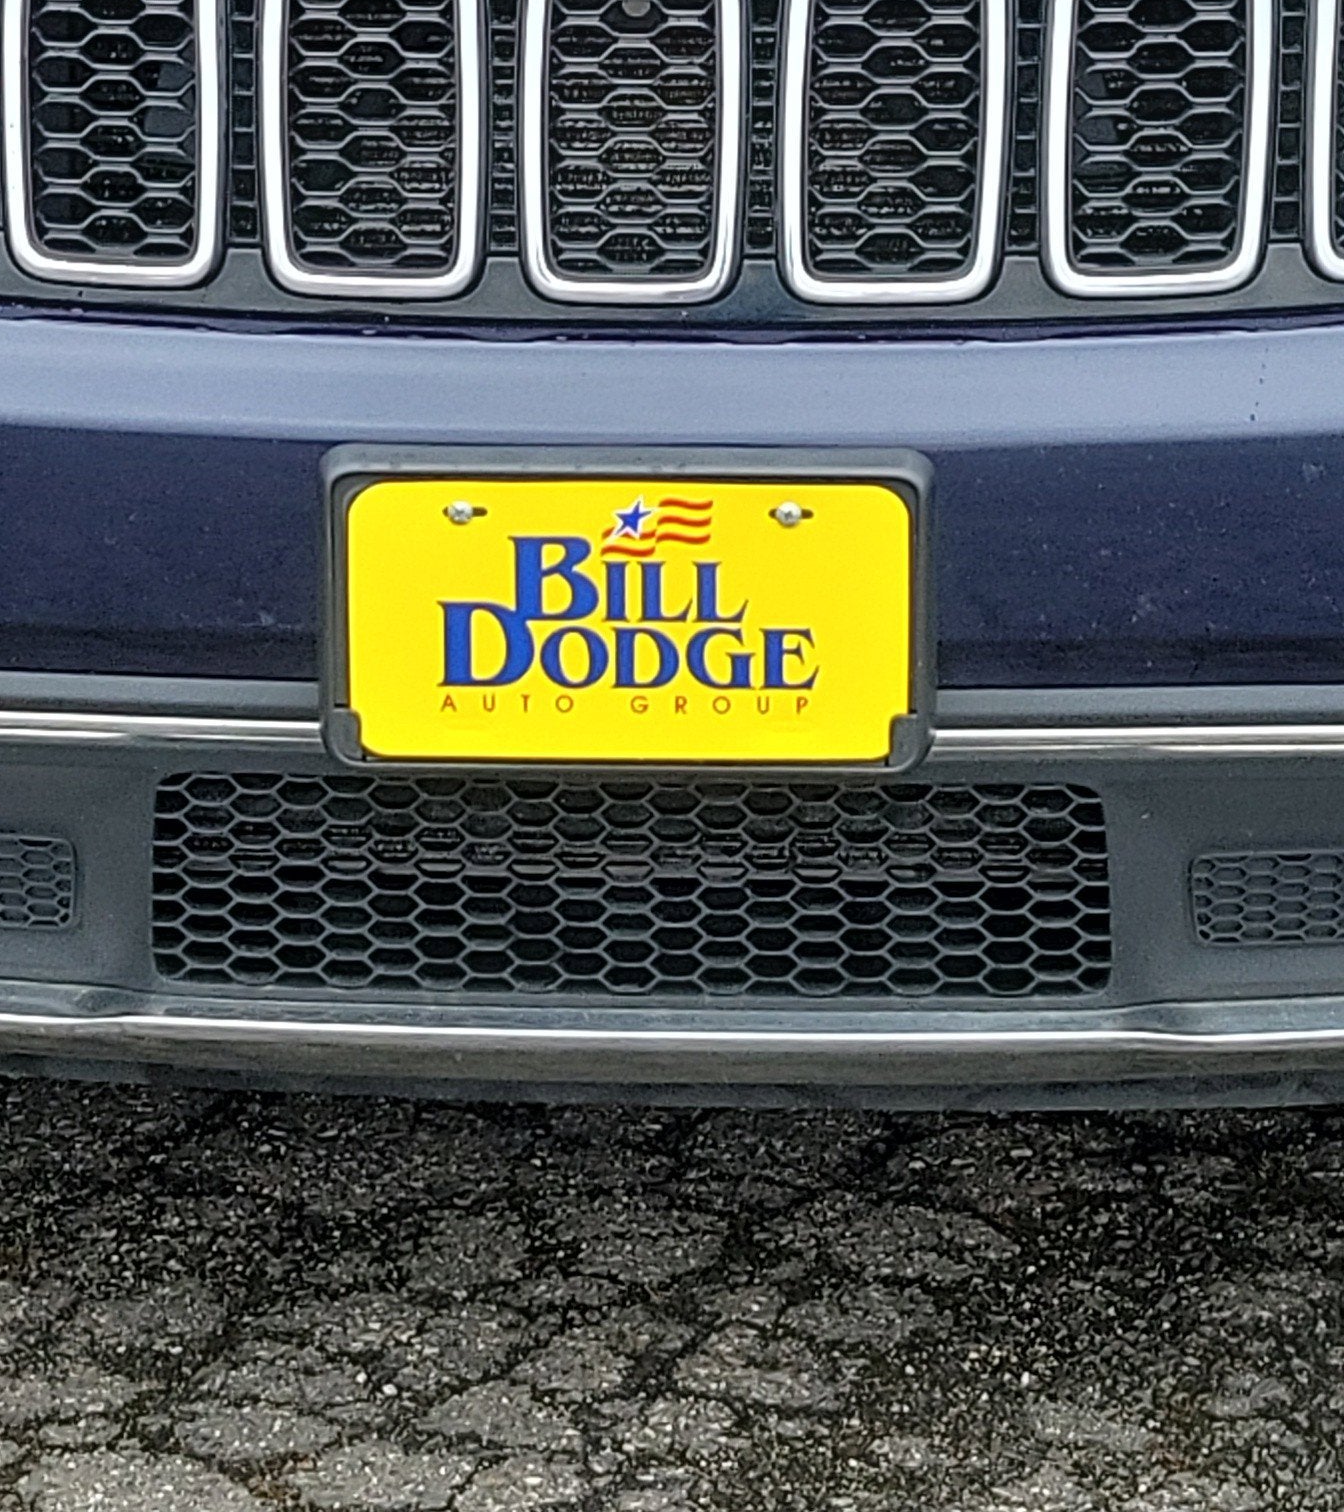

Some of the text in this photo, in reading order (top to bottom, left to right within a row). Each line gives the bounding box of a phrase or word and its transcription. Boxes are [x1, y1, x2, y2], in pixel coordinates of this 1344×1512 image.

[507, 535, 749, 624] BILL
[436, 600, 821, 690] DODGE
[439, 694, 810, 716] AUTO GROUP
